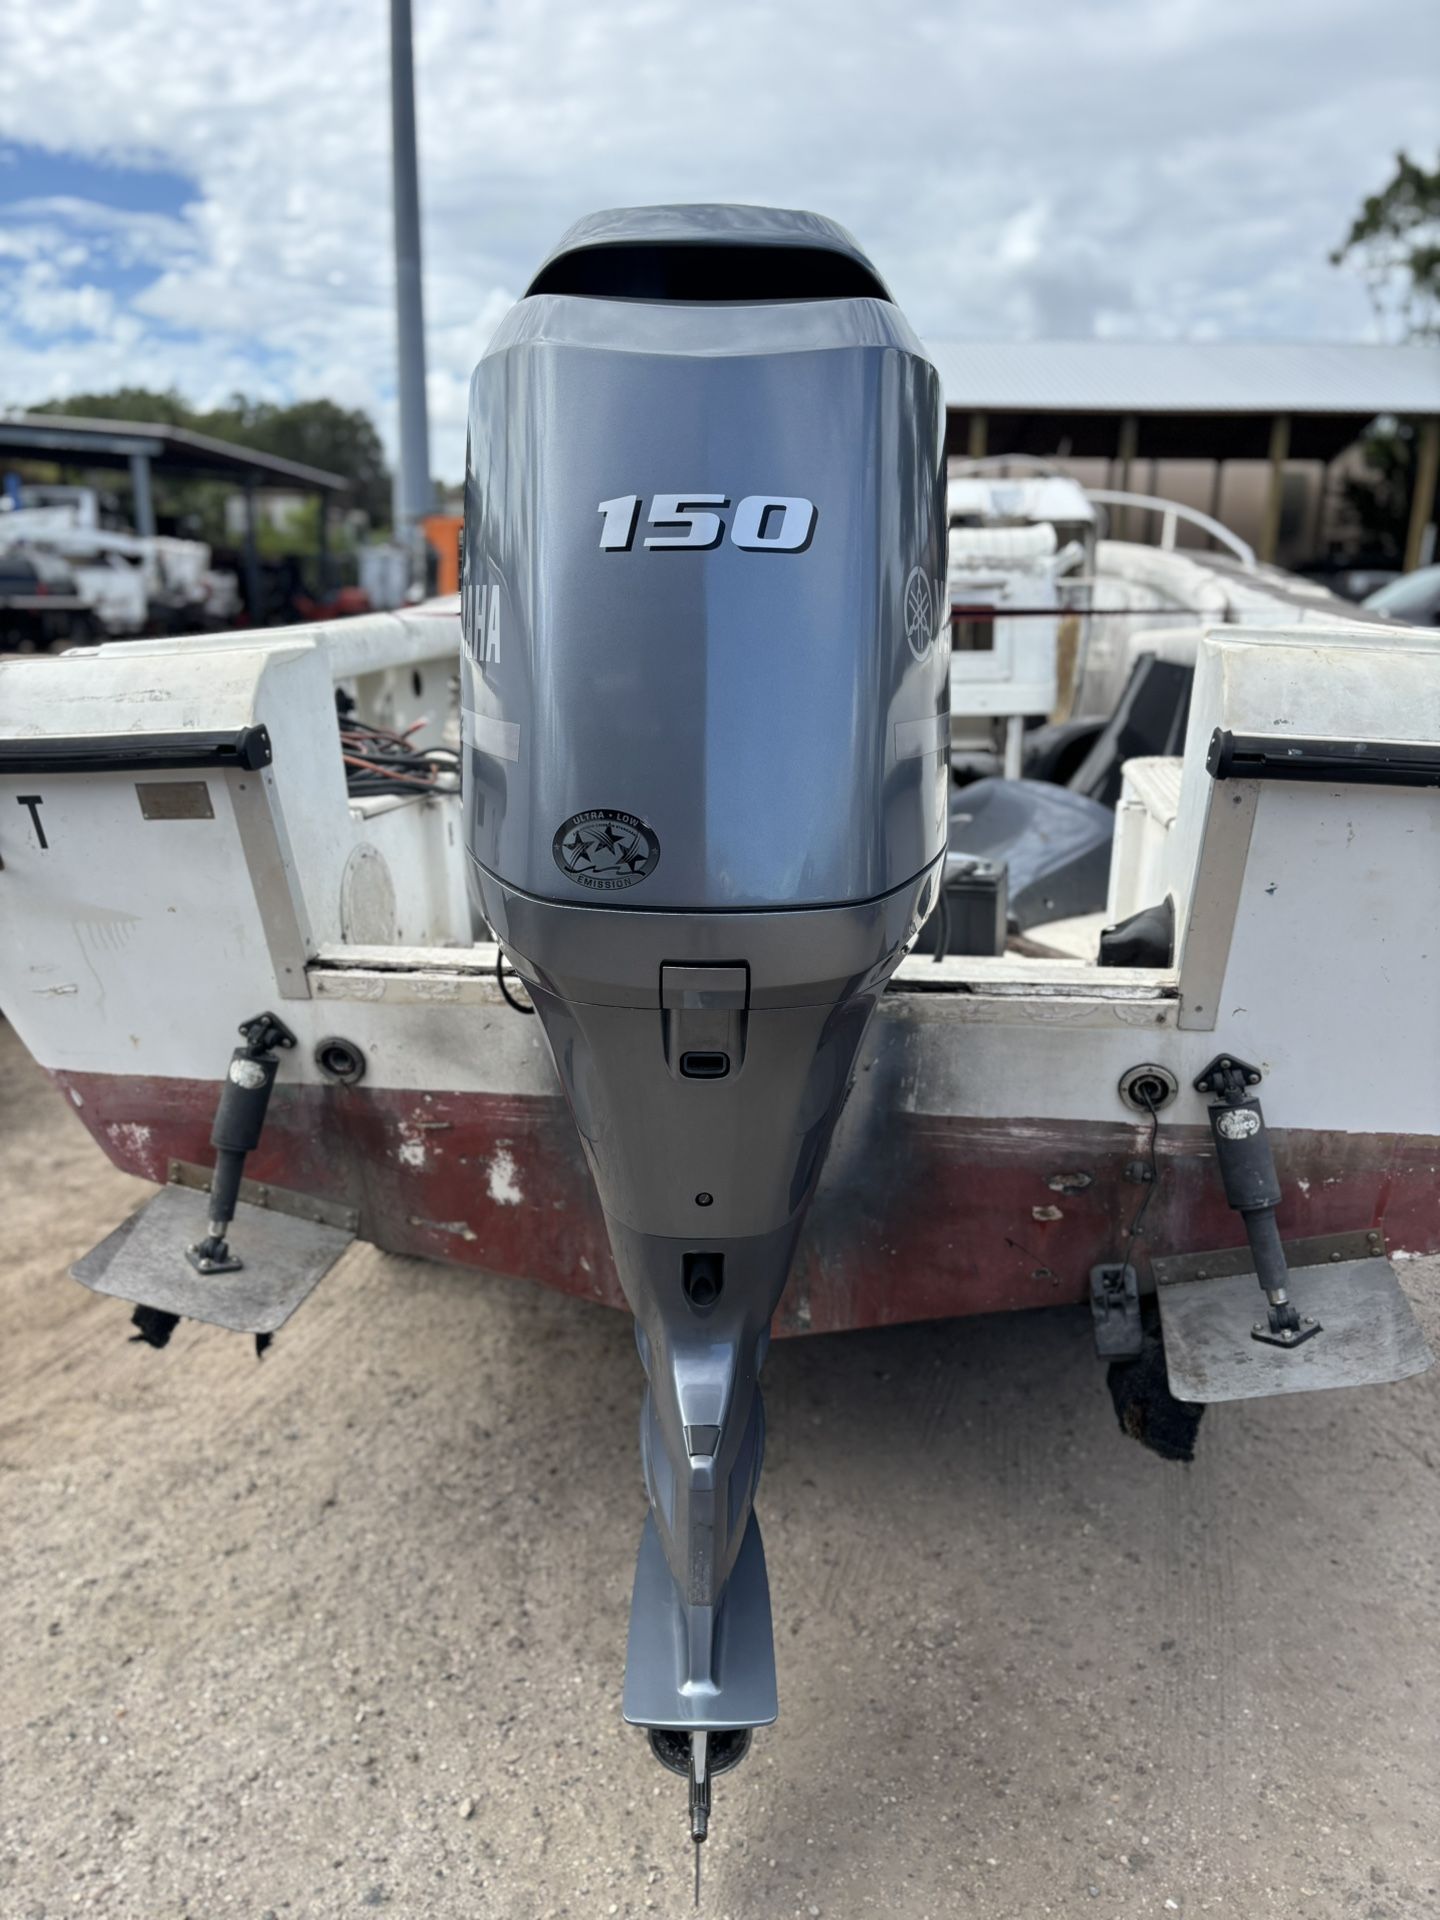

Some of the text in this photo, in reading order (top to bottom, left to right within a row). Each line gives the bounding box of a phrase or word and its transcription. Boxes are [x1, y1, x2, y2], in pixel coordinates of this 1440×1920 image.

[597, 494, 818, 554] 150
[16, 795, 48, 849] T
[573, 811, 640, 826] ULTRA LOW
[577, 875, 632, 889] EMISSION
